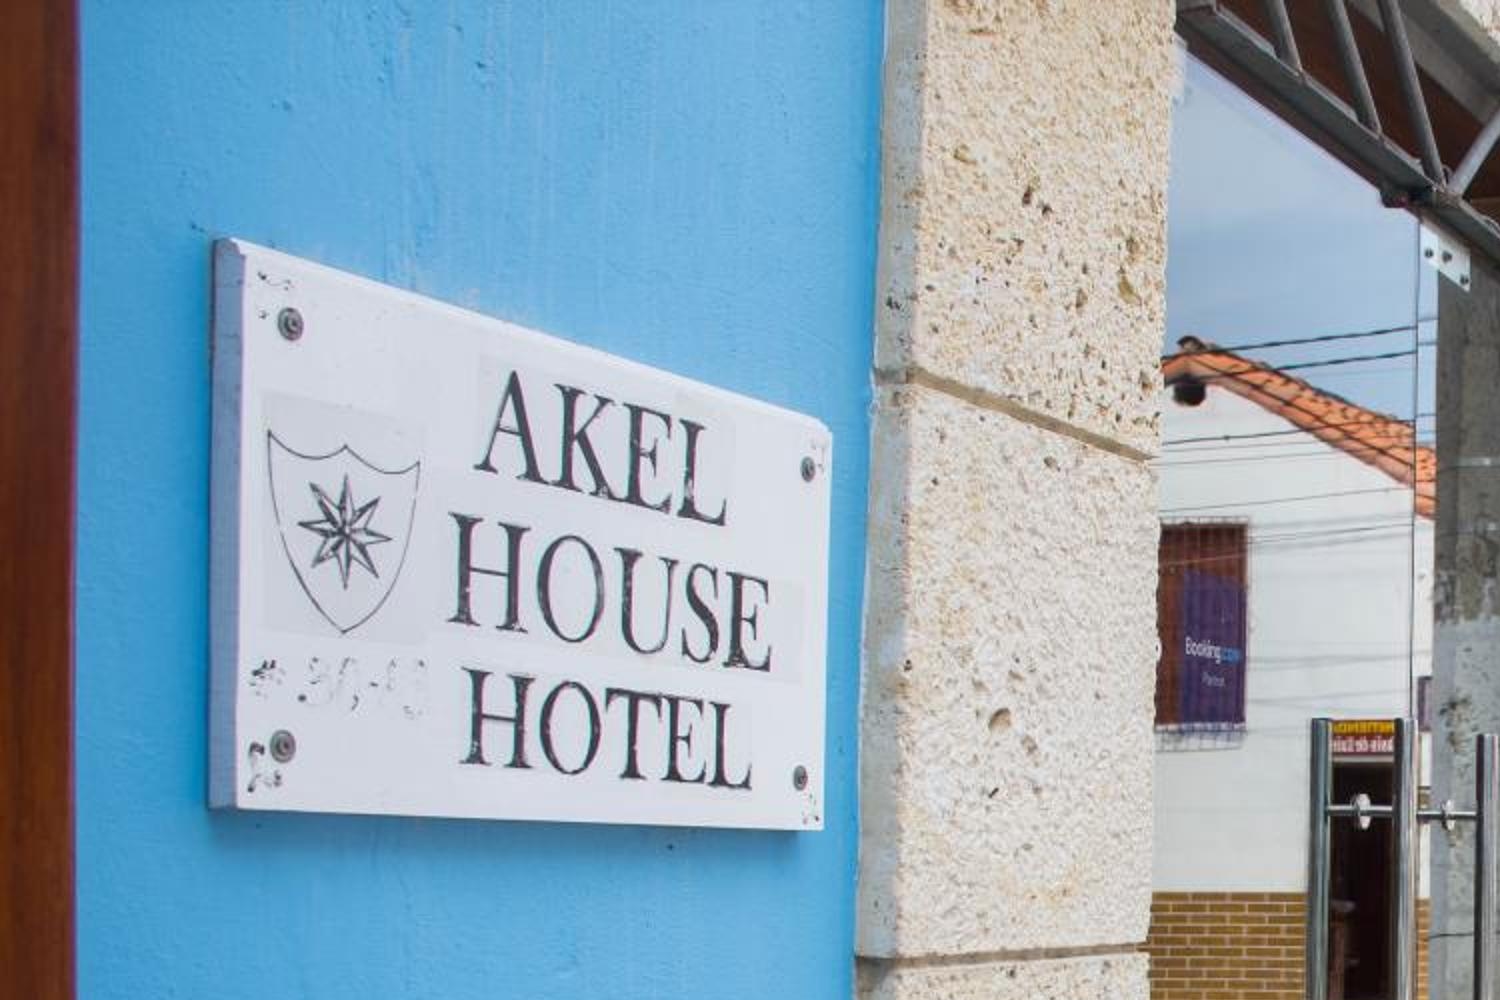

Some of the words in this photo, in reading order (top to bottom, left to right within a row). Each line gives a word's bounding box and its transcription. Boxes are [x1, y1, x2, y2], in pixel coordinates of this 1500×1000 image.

[473, 370, 728, 526] AKEL
[445, 511, 773, 673] HOUSE
[458, 666, 753, 791] HOTEL
